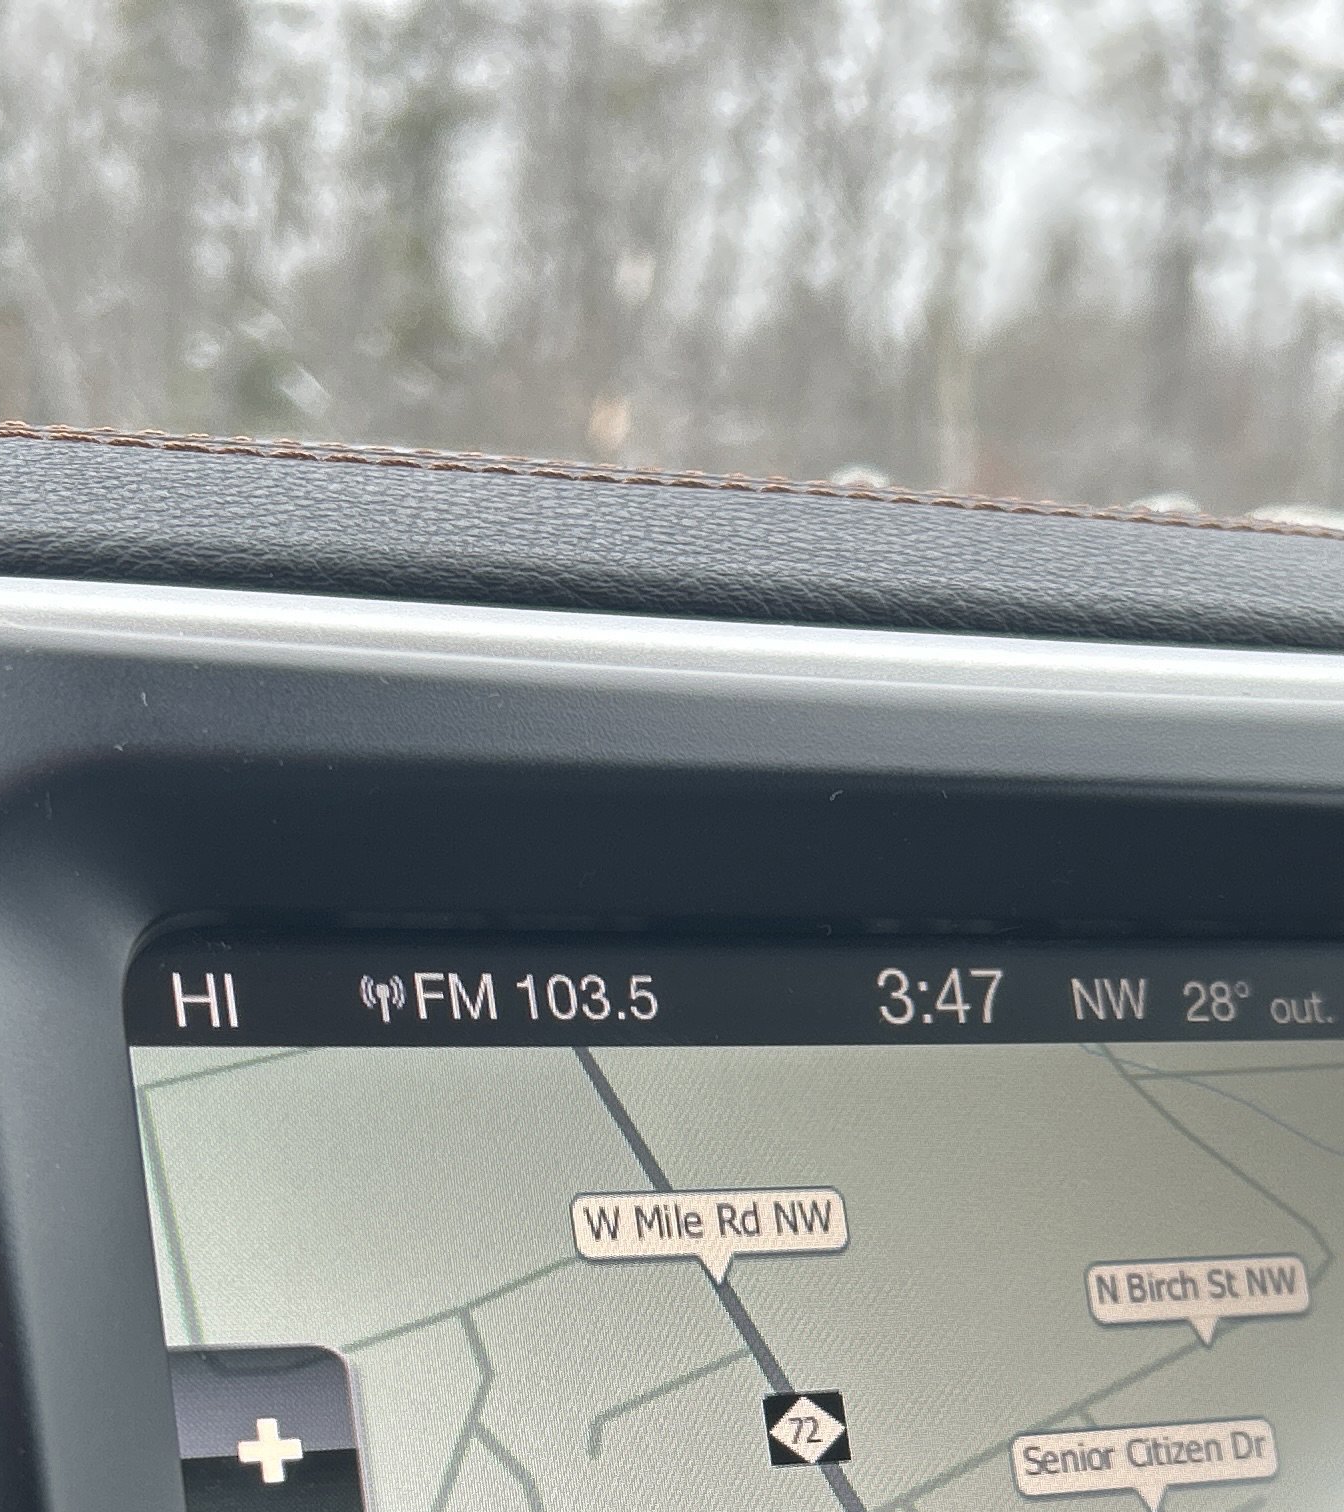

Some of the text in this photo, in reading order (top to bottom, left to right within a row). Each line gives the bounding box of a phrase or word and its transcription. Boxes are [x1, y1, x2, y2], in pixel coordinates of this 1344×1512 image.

[170, 970, 241, 1029] HI
[413, 971, 659, 1021] FM 103.5
[875, 967, 1005, 1026] 3:47
[1069, 977, 1149, 1022] NW
[1269, 992, 1335, 1026] out.
[583, 1199, 835, 1241] W Mile Rd NW
[1095, 1264, 1300, 1306] N Birch St NW
[786, 1416, 823, 1446] 72
[1023, 1430, 1269, 1478] Senior Citizen Dr
